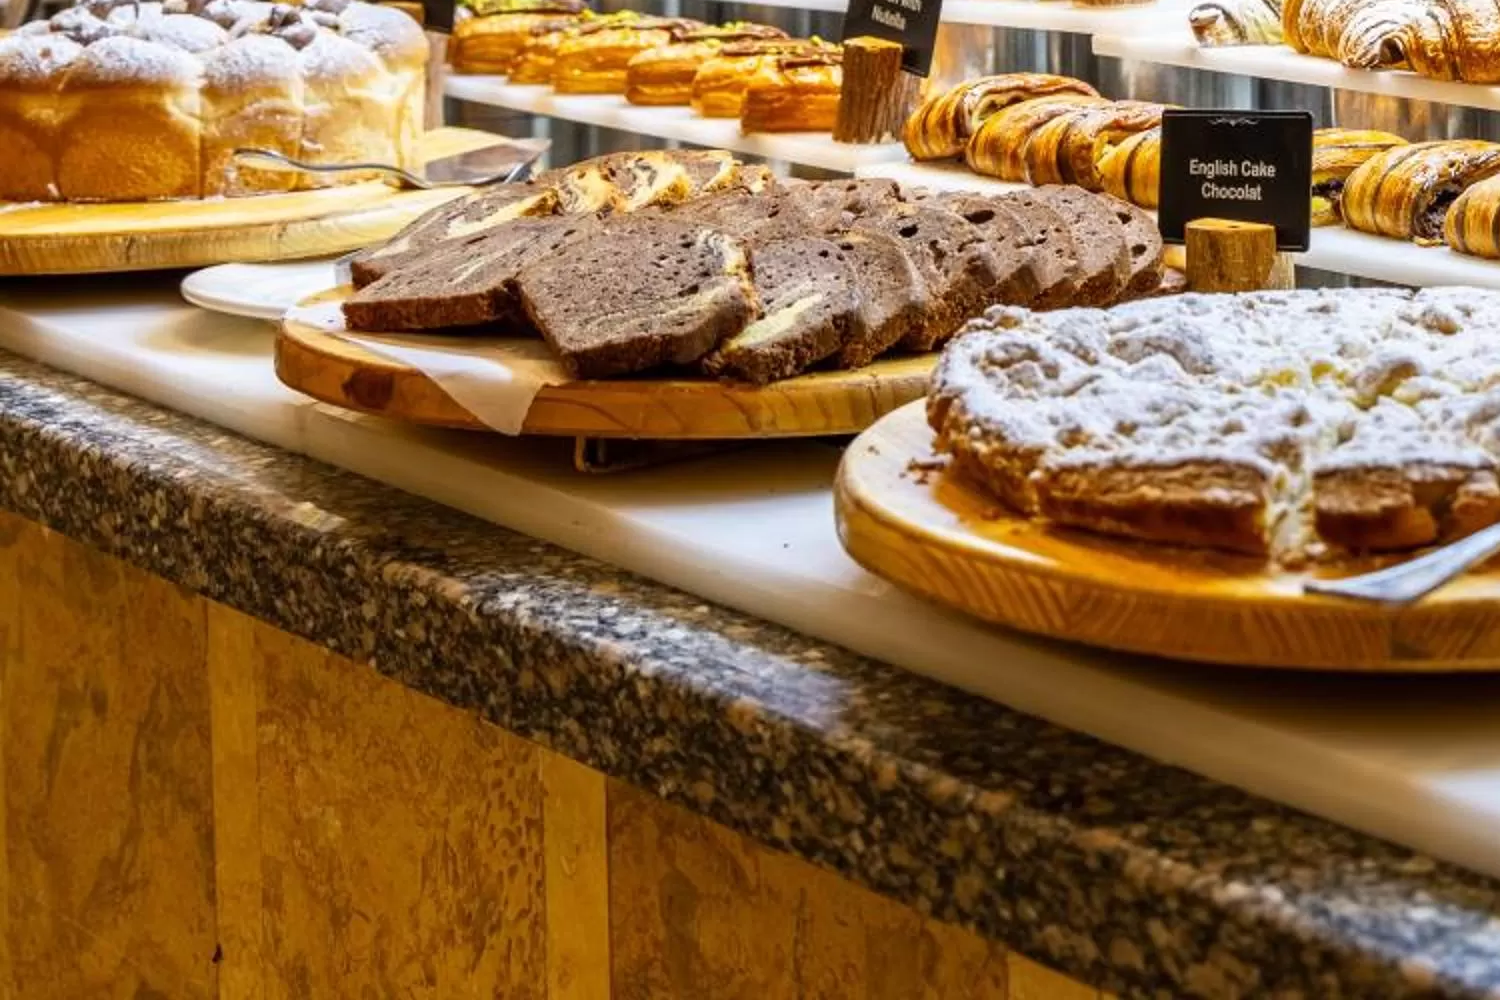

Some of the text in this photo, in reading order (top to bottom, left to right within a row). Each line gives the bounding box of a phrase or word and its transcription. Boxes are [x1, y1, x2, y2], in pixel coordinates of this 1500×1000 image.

[1189, 159, 1276, 179] English Cake
[1201, 182, 1262, 200] Chocolat
